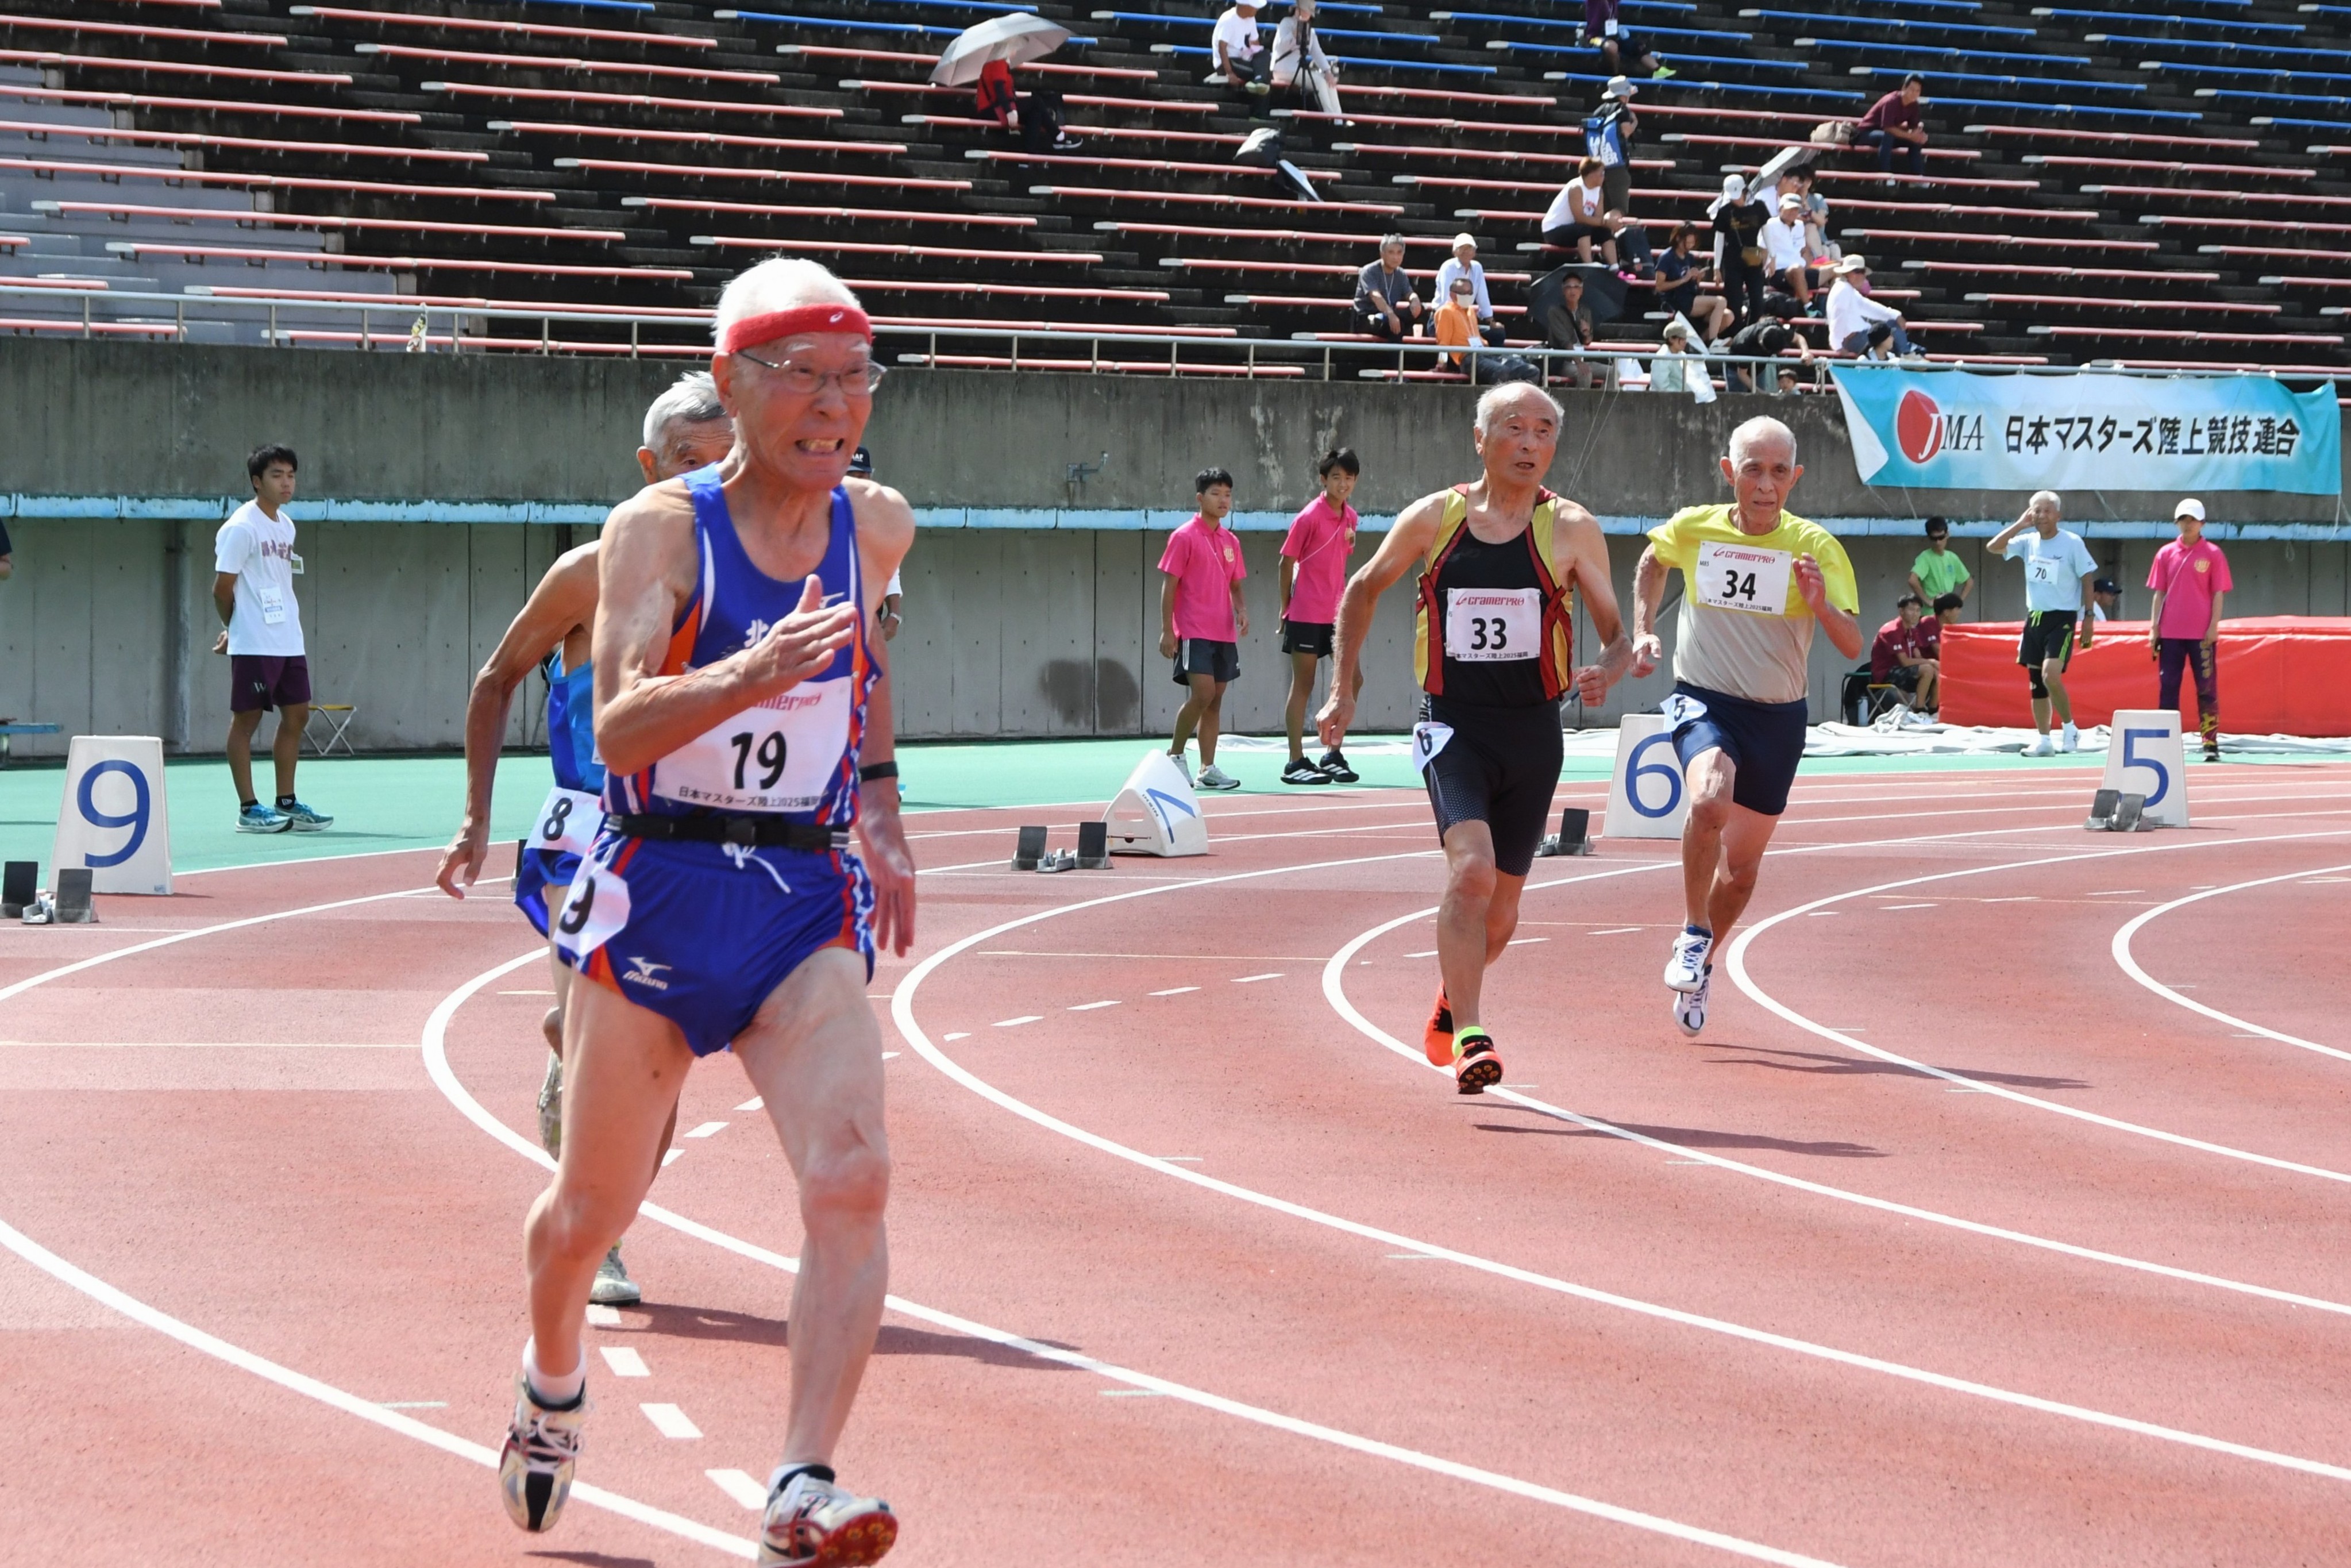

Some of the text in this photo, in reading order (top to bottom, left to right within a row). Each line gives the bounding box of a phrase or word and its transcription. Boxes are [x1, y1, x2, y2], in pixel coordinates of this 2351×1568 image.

[1918, 413, 1985, 460] JMA
[2006, 415, 2300, 457] 日本マスターズ陸上競技連合
[1722, 569, 1756, 601] 34
[2035, 567, 2046, 579] 70
[1707, 598, 1772, 612] 本マスターズ陸上2025福岡
[1471, 618, 1507, 650] 33
[1674, 696, 1685, 722] 5
[731, 730, 787, 790] 19
[1417, 728, 1432, 756] 6
[1625, 732, 1681, 818] 6
[2118, 729, 2170, 808] 5
[76, 760, 150, 868] 9
[543, 798, 573, 841] 8
[1146, 788, 1196, 845] 7
